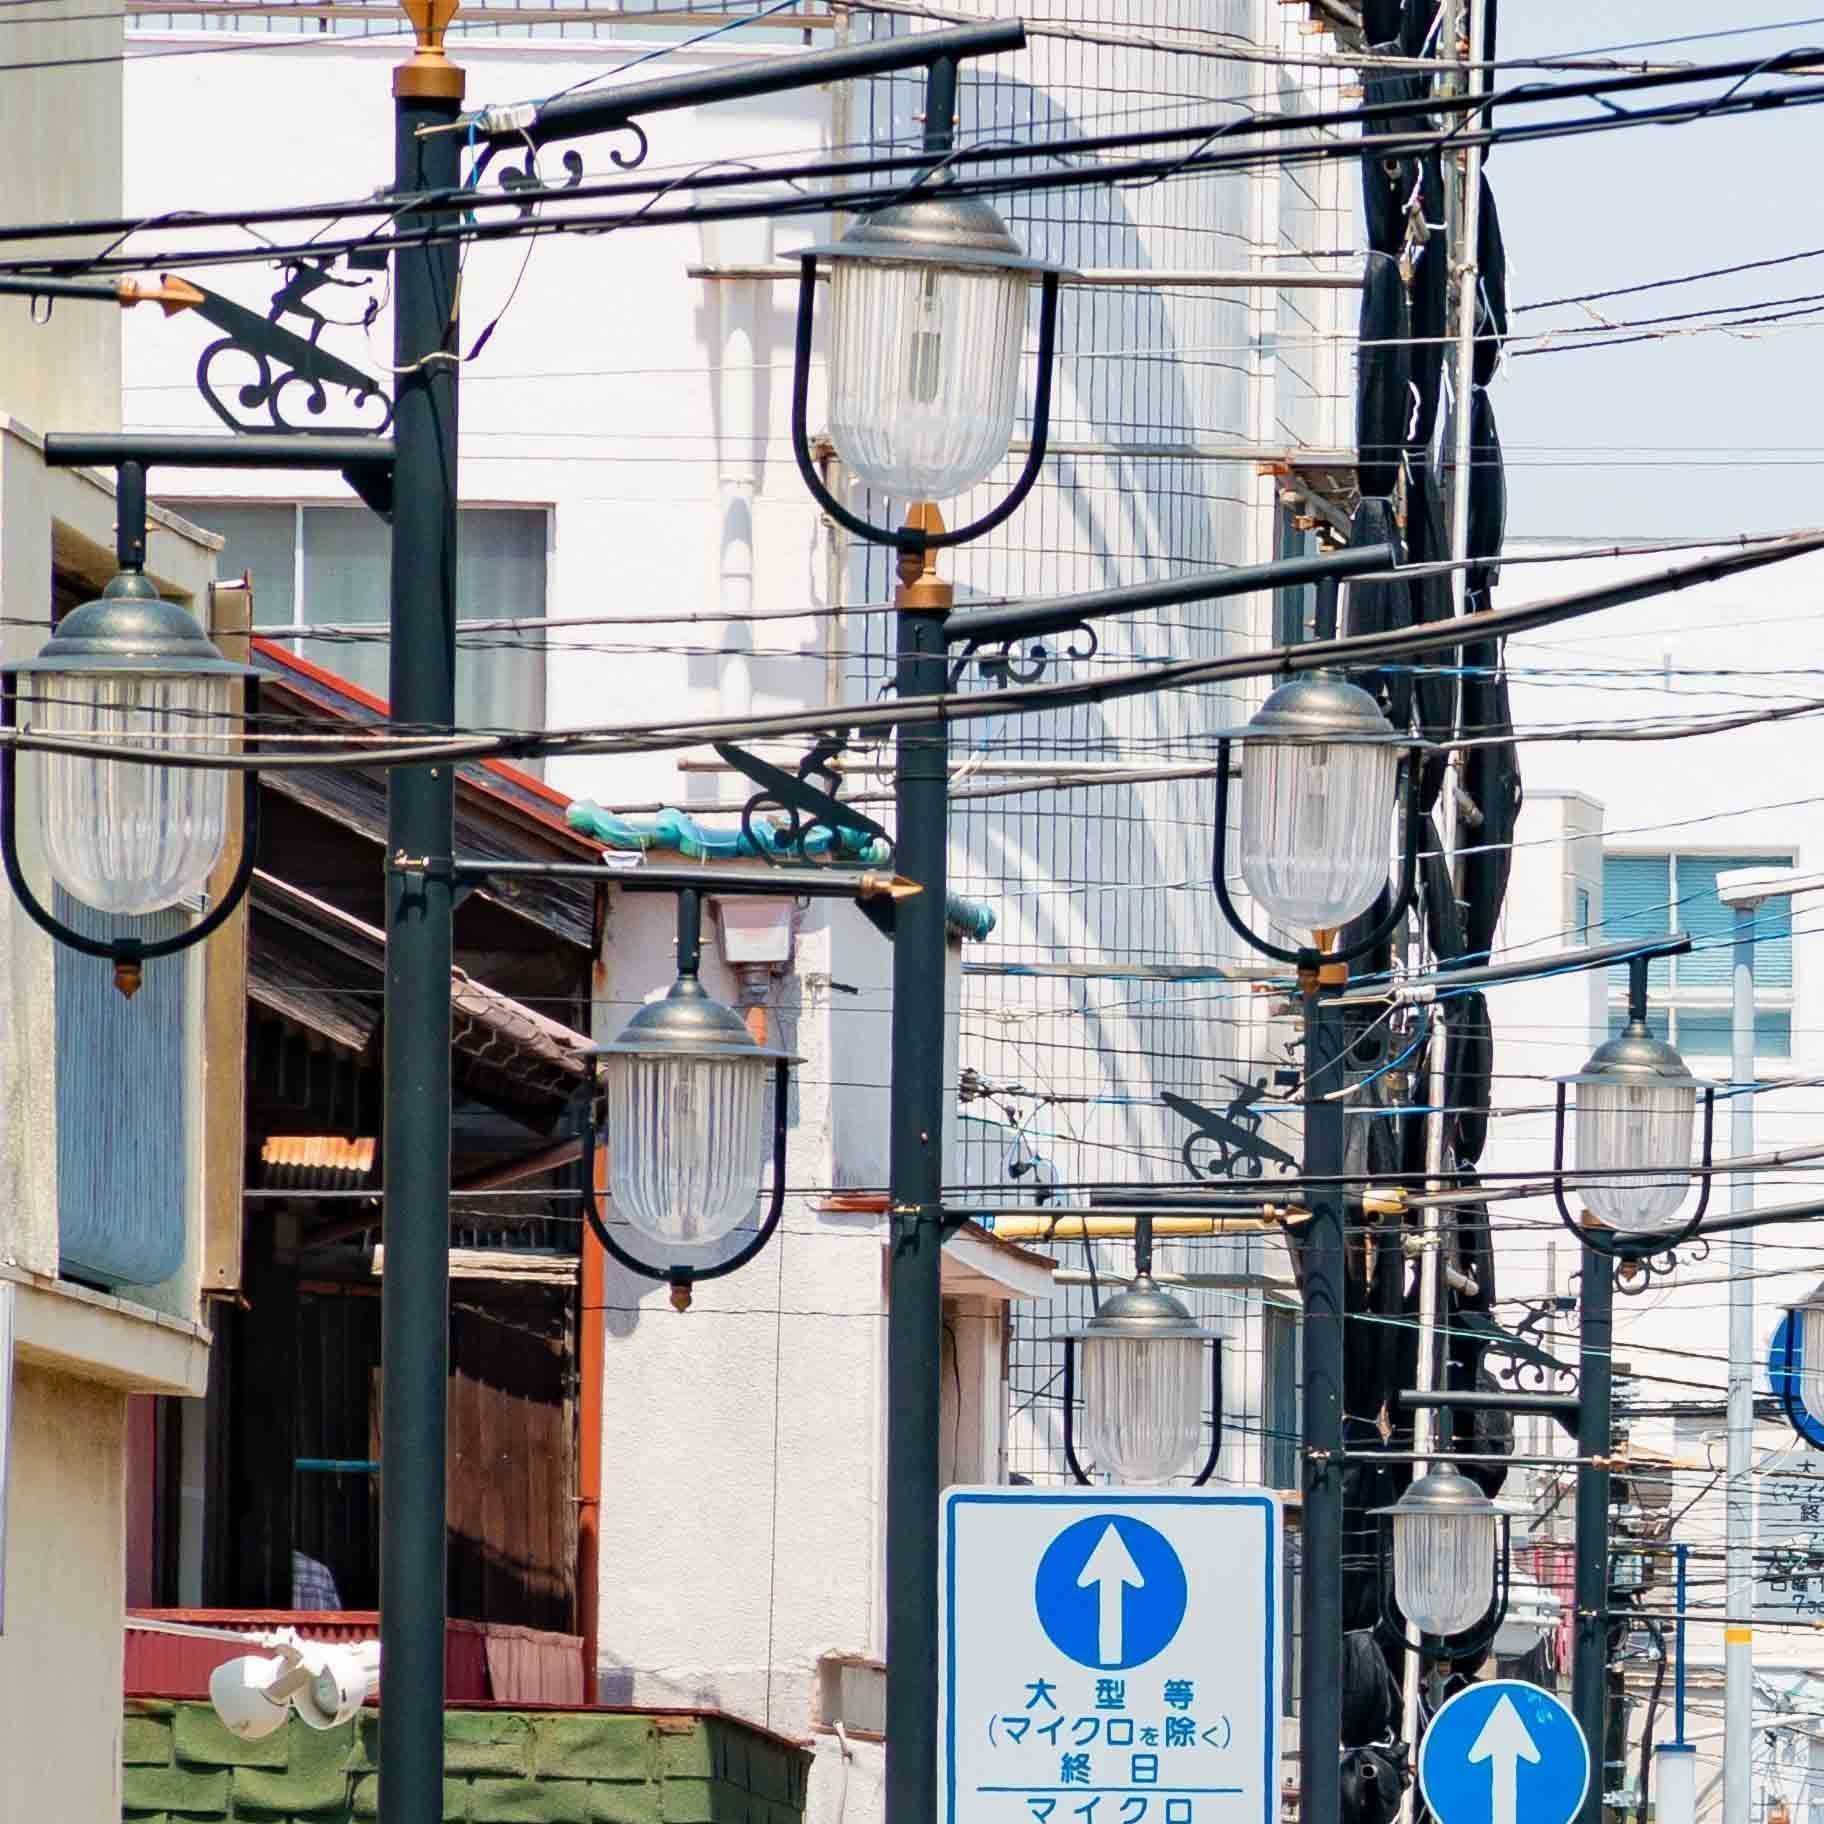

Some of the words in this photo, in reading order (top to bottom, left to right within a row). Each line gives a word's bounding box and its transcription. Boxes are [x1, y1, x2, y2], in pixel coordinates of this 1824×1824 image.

[1026, 1678, 1195, 1711] 大型等
[988, 1714, 1231, 1749] (マイクロを除く)
[1061, 1753, 1159, 1785] 終日
